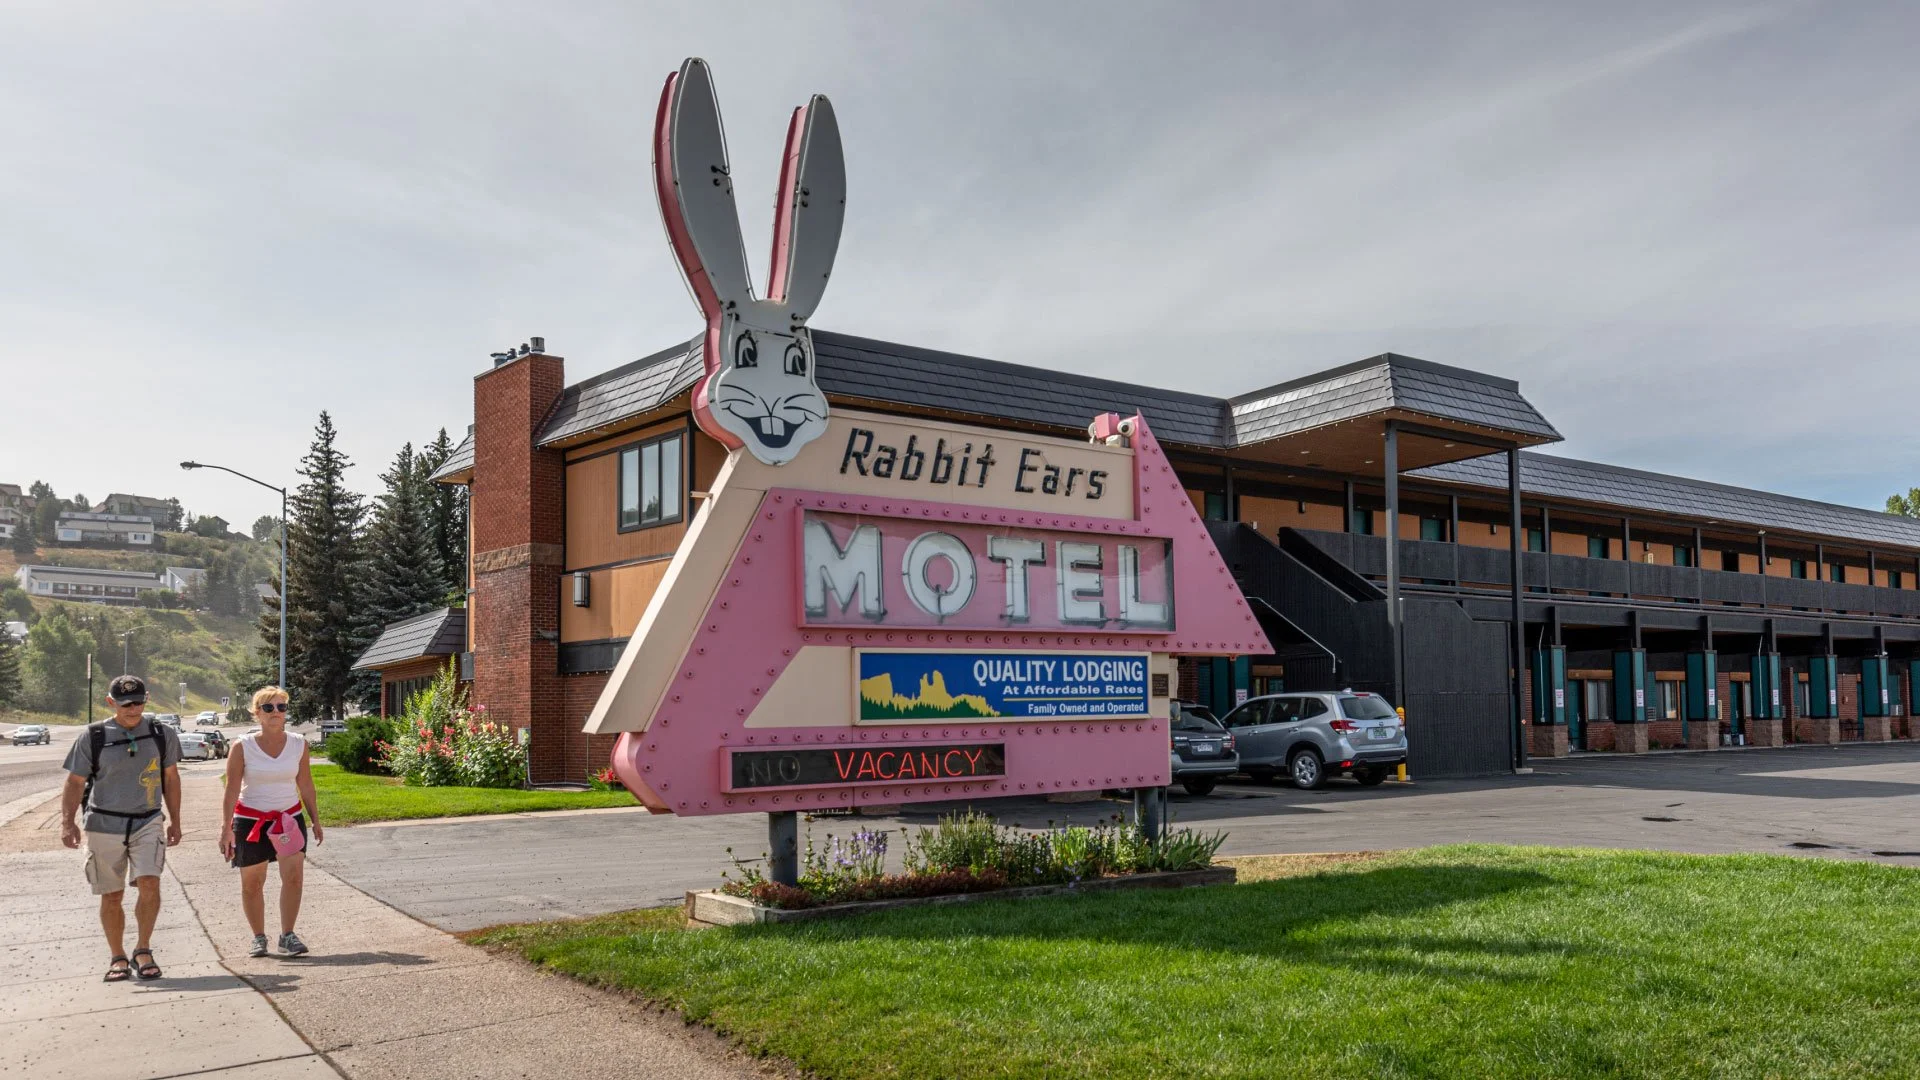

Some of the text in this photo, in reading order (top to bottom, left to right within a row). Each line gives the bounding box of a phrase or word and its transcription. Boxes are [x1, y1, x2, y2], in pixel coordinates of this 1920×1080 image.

[840, 427, 1109, 500] Rabbit Ears
[804, 519, 1168, 624] MOTEL
[973, 659, 1143, 687] QUALITY LODGING
[1003, 685, 1019, 695] At
[1024, 685, 1100, 695] Affordable
[1105, 685, 1143, 694] Rates
[1028, 702, 1144, 715] Family Owned and Operated
[750, 749, 983, 784] NO VACANCY
